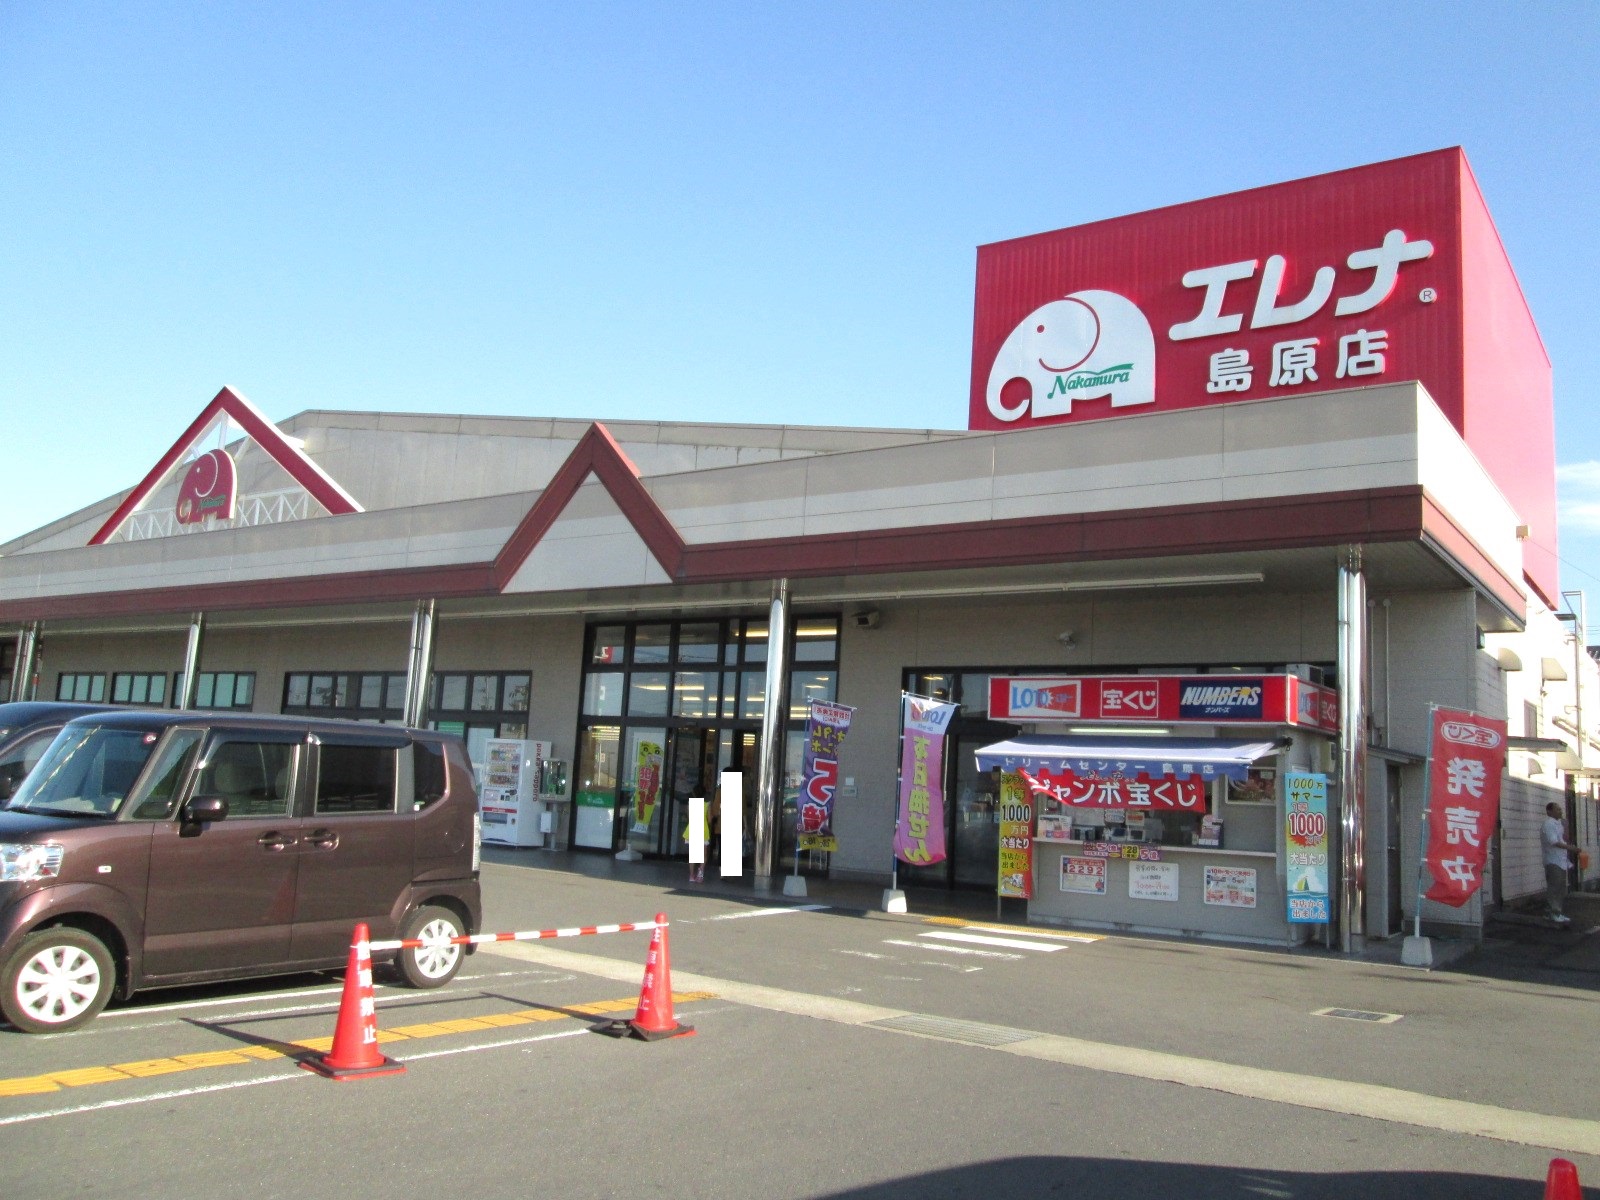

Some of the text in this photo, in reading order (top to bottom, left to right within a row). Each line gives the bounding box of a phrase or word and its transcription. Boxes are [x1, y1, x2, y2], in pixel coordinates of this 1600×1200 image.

[1168, 229, 1434, 340] エレナ
[1206, 329, 1388, 394] 島原店
[1047, 367, 1131, 399] Nakamura
[1103, 689, 1156, 711] 宝くじ
[1181, 686, 1261, 706] NUMBERS
[1006, 757, 1146, 770] ドリームセンター
[1290, 792, 1323, 801] サマー
[1289, 813, 1325, 836] 1000
[1001, 838, 1030, 849] 大当たり
[1290, 853, 1325, 865] 大当たり
[1001, 862, 1029, 871] 出ました
[1068, 864, 1103, 876] 2292
[1290, 899, 1325, 909] 当店から
[1292, 909, 1327, 919] 出ました
